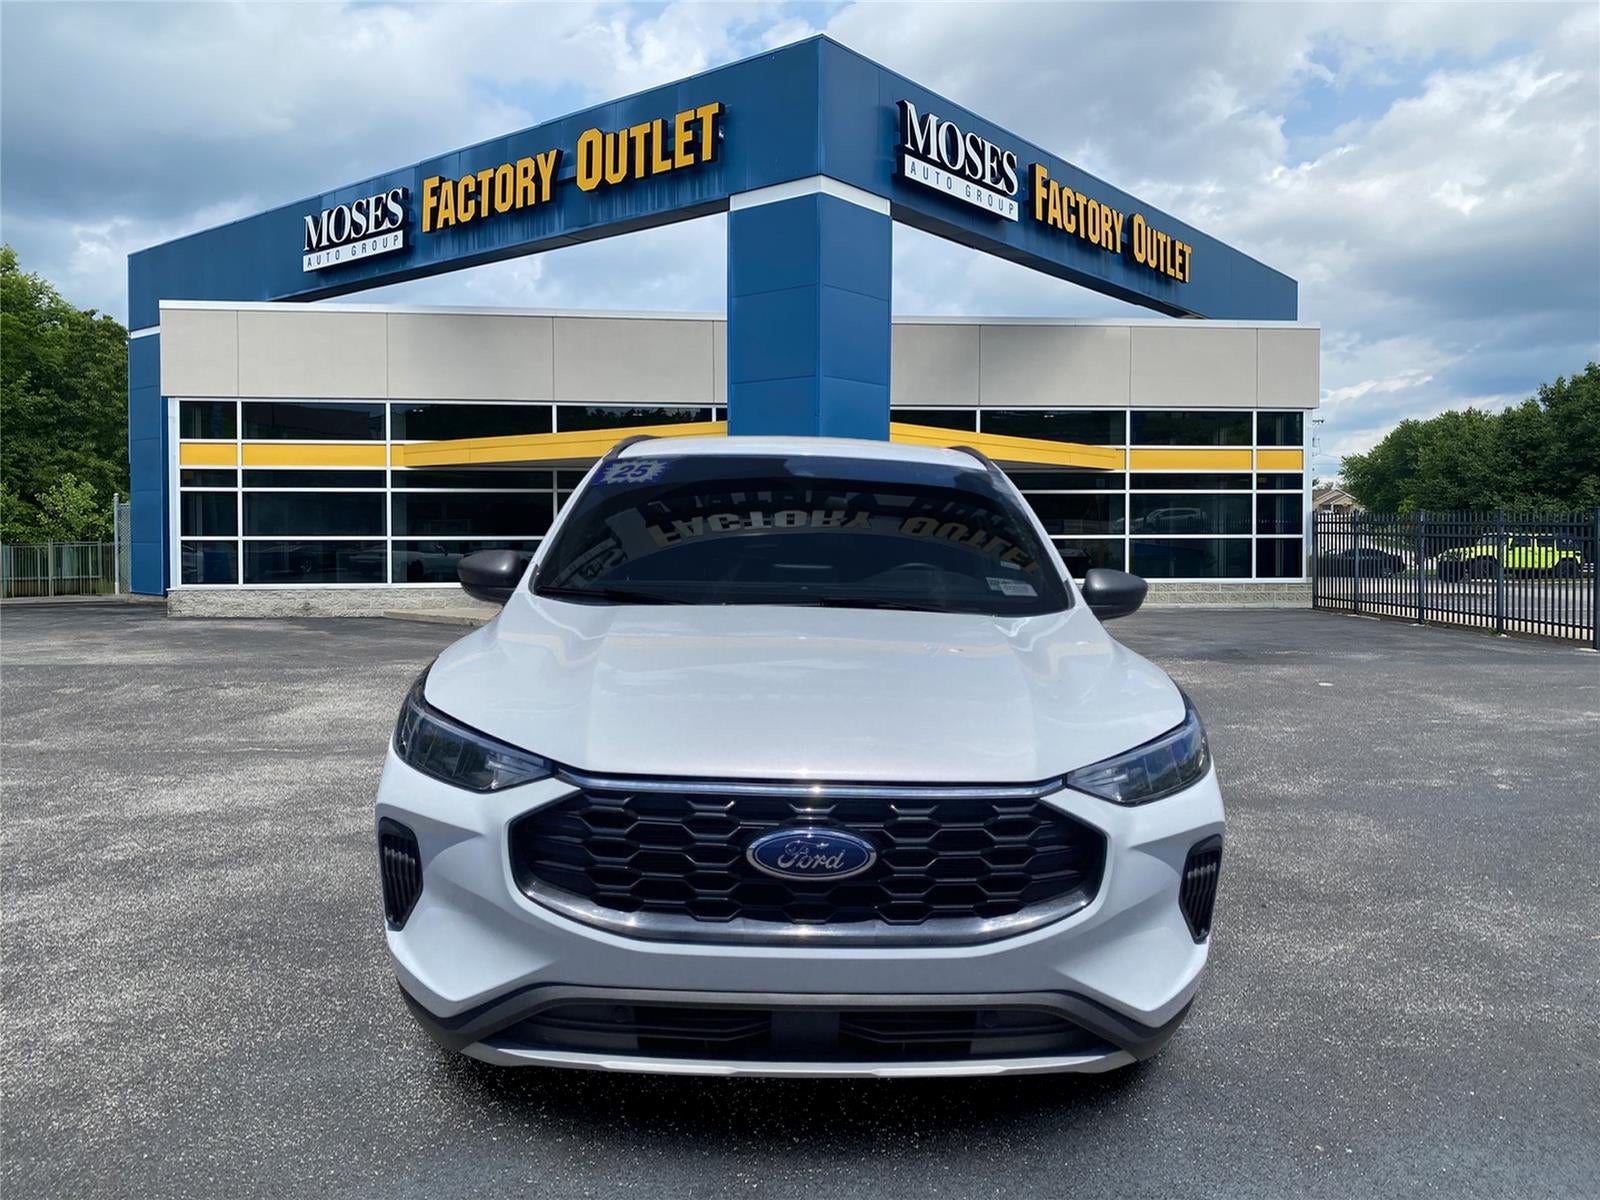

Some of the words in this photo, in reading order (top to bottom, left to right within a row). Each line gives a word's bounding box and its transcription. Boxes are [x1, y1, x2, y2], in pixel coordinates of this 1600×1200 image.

[421, 149, 558, 233] FACTORY
[576, 102, 720, 192] OUTLET
[903, 100, 1018, 196] MOSES
[910, 161, 953, 190] AUTO
[965, 184, 1014, 215] GROUP
[303, 187, 404, 251] MOSES
[1034, 163, 1123, 254] FACTORY
[1131, 212, 1192, 284] OUTLET
[307, 249, 340, 268] AUTO
[350, 234, 399, 257] GROUP
[612, 464, 653, 478] 25
[777, 840, 846, 869] Ford
